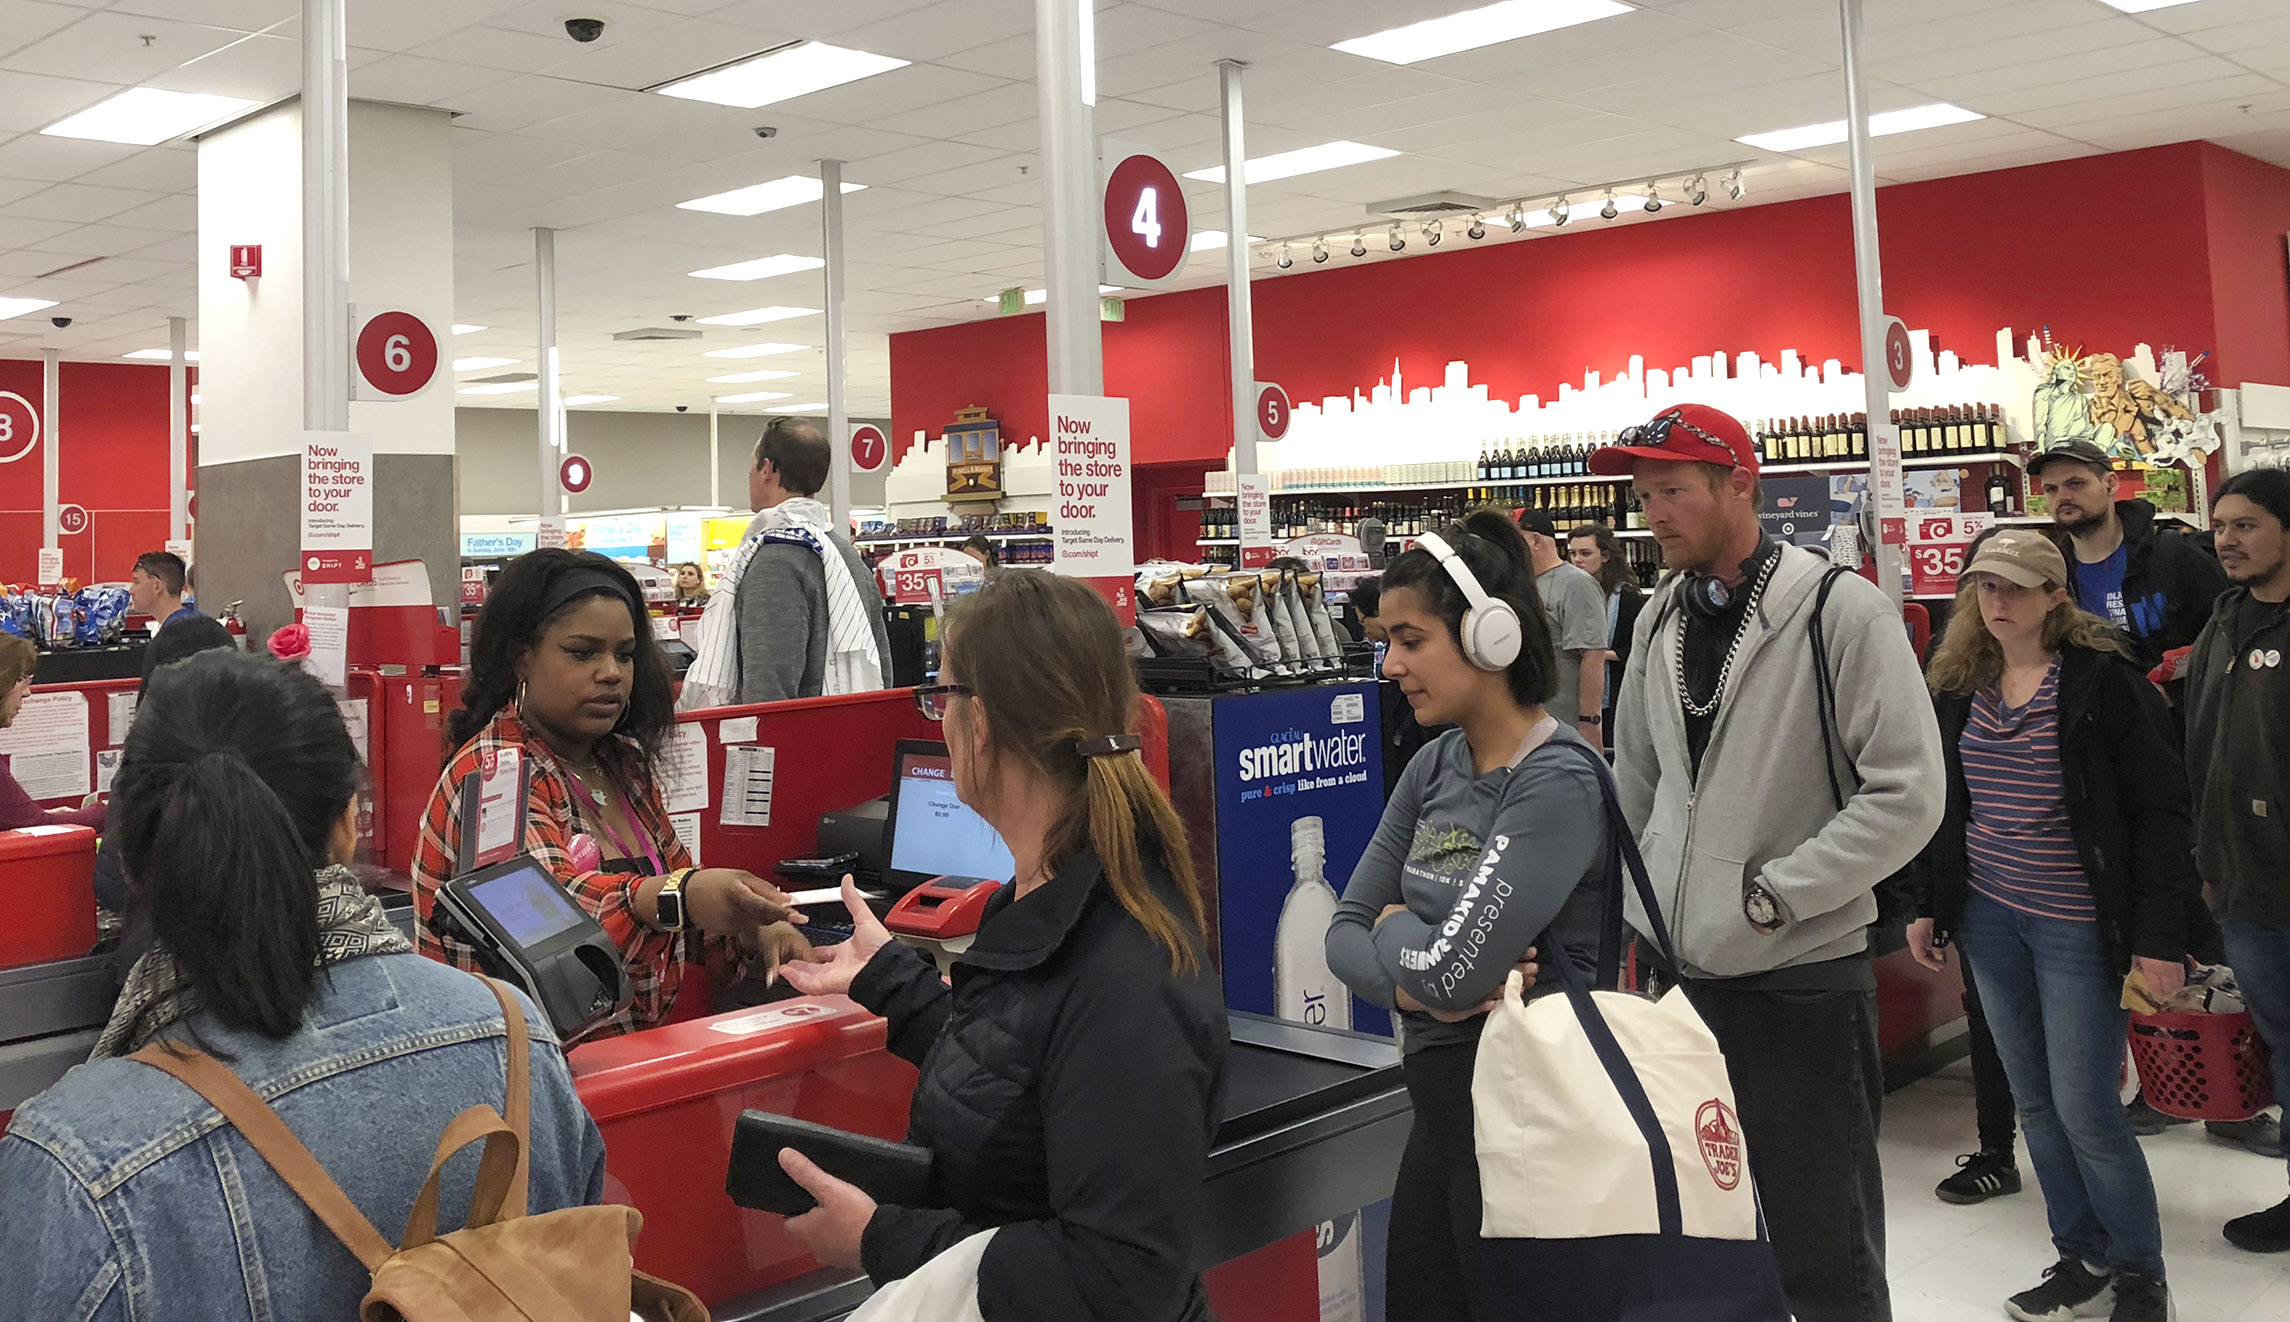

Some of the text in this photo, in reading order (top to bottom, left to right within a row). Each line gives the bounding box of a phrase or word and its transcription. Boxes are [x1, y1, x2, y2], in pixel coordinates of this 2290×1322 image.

[1132, 187, 1162, 249] 4
[384, 334, 412, 373] 6
[1894, 340, 1904, 371] 3
[1268, 400, 1279, 425] 5
[1057, 415, 1092, 434] Now
[308, 445, 338, 457] Now
[862, 438, 874, 459] 7
[1058, 436, 1117, 460] bringing
[308, 459, 360, 472] bringing
[1058, 459, 1123, 478] the store
[308, 473, 365, 485] the store
[308, 487, 352, 500] to your
[1059, 480, 1109, 501] to your
[308, 502, 340, 512] door.
[1060, 501, 1097, 519] door.
[1757, 510, 1795, 521] vineyard
[65, 512, 82, 526] 15
[467, 537, 523, 547] Father's Day
[1061, 536, 1078, 545] Target
[1078, 536, 1093, 544] Same
[1093, 536, 1104, 544] Day
[911, 766, 946, 778] CHANGE
[1241, 769, 1368, 803] pure & crisp like from a cloud
[1442, 834, 1511, 938] PAMAKID
[1441, 877, 1514, 999] presented
[1704, 1142, 1739, 1161] TRADER
[1714, 1160, 1737, 1177] JOE'S
